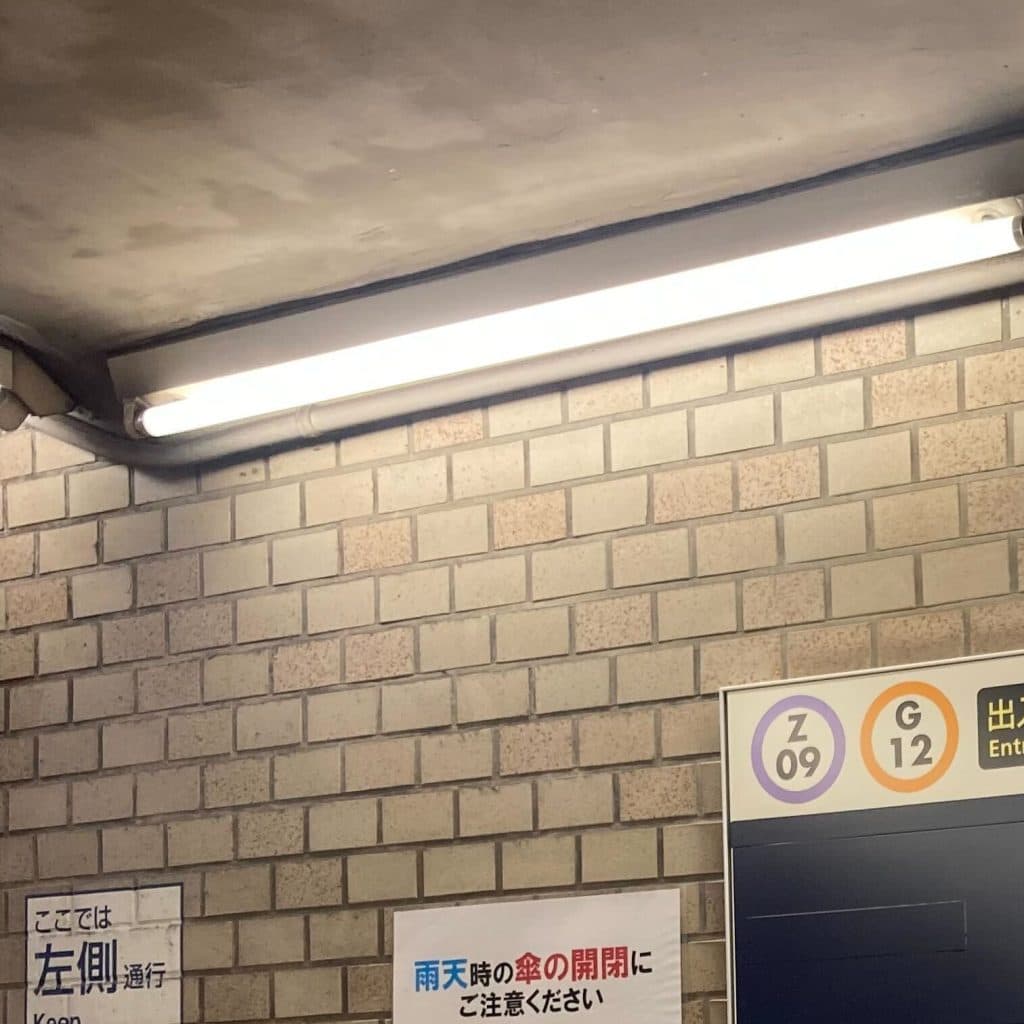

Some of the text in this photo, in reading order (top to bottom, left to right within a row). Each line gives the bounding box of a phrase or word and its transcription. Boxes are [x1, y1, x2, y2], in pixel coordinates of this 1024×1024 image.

[787, 714, 807, 743] Z
[896, 700, 921, 730] G
[776, 747, 820, 780] 09
[891, 734, 932, 768] 12
[35, 905, 112, 933] ここでは
[414, 946, 653, 992] 雨天時の傘の開閉に
[460, 988, 603, 1018] ご注意ください
